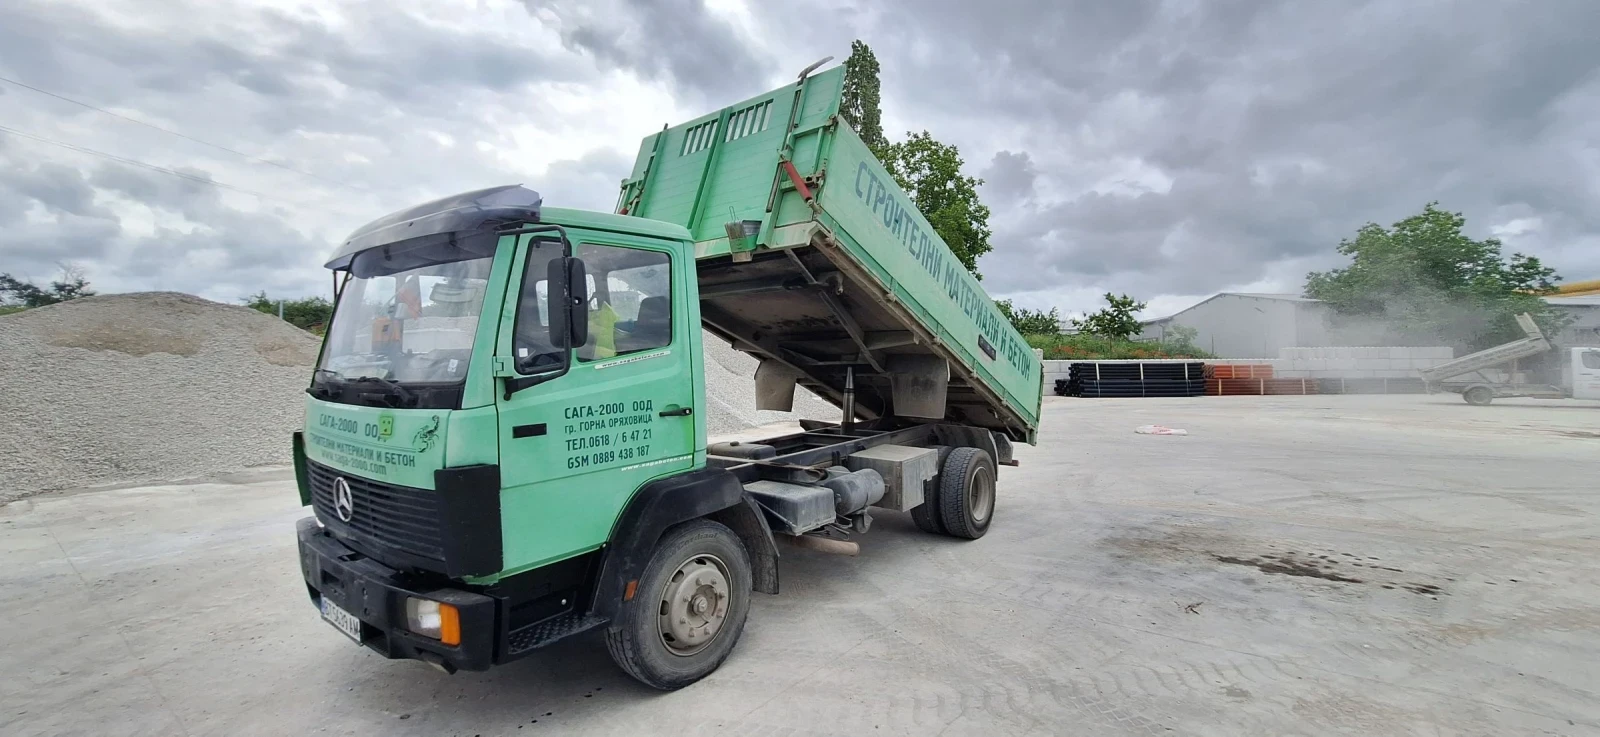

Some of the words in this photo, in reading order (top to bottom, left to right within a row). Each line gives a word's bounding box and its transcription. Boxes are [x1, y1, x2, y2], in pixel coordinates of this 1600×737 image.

[855, 160, 943, 282] СТРОИТЕЛНИ
[943, 262, 1000, 346] МАТЕРИАЛИ
[1000, 327, 1007, 355] И
[1008, 336, 1031, 381] БЕТОН
[564, 402, 624, 419] САГА-2000
[632, 400, 653, 412] ООД
[320, 413, 358, 434] САГА-2000
[564, 425, 577, 434] гр.
[580, 420, 606, 432] ГОРНА
[608, 413, 653, 428] ОРЯХОВИЦА
[565, 434, 610, 452] ТЕЛ.0618
[622, 431, 627, 443] 6
[630, 429, 640, 441] 47
[642, 428, 652, 440] 21
[384, 451, 416, 468] БЕТОН
[567, 454, 589, 470] GSM
[592, 450, 615, 465] 0889
[618, 447, 634, 460] 438
[636, 444, 650, 457] 187
